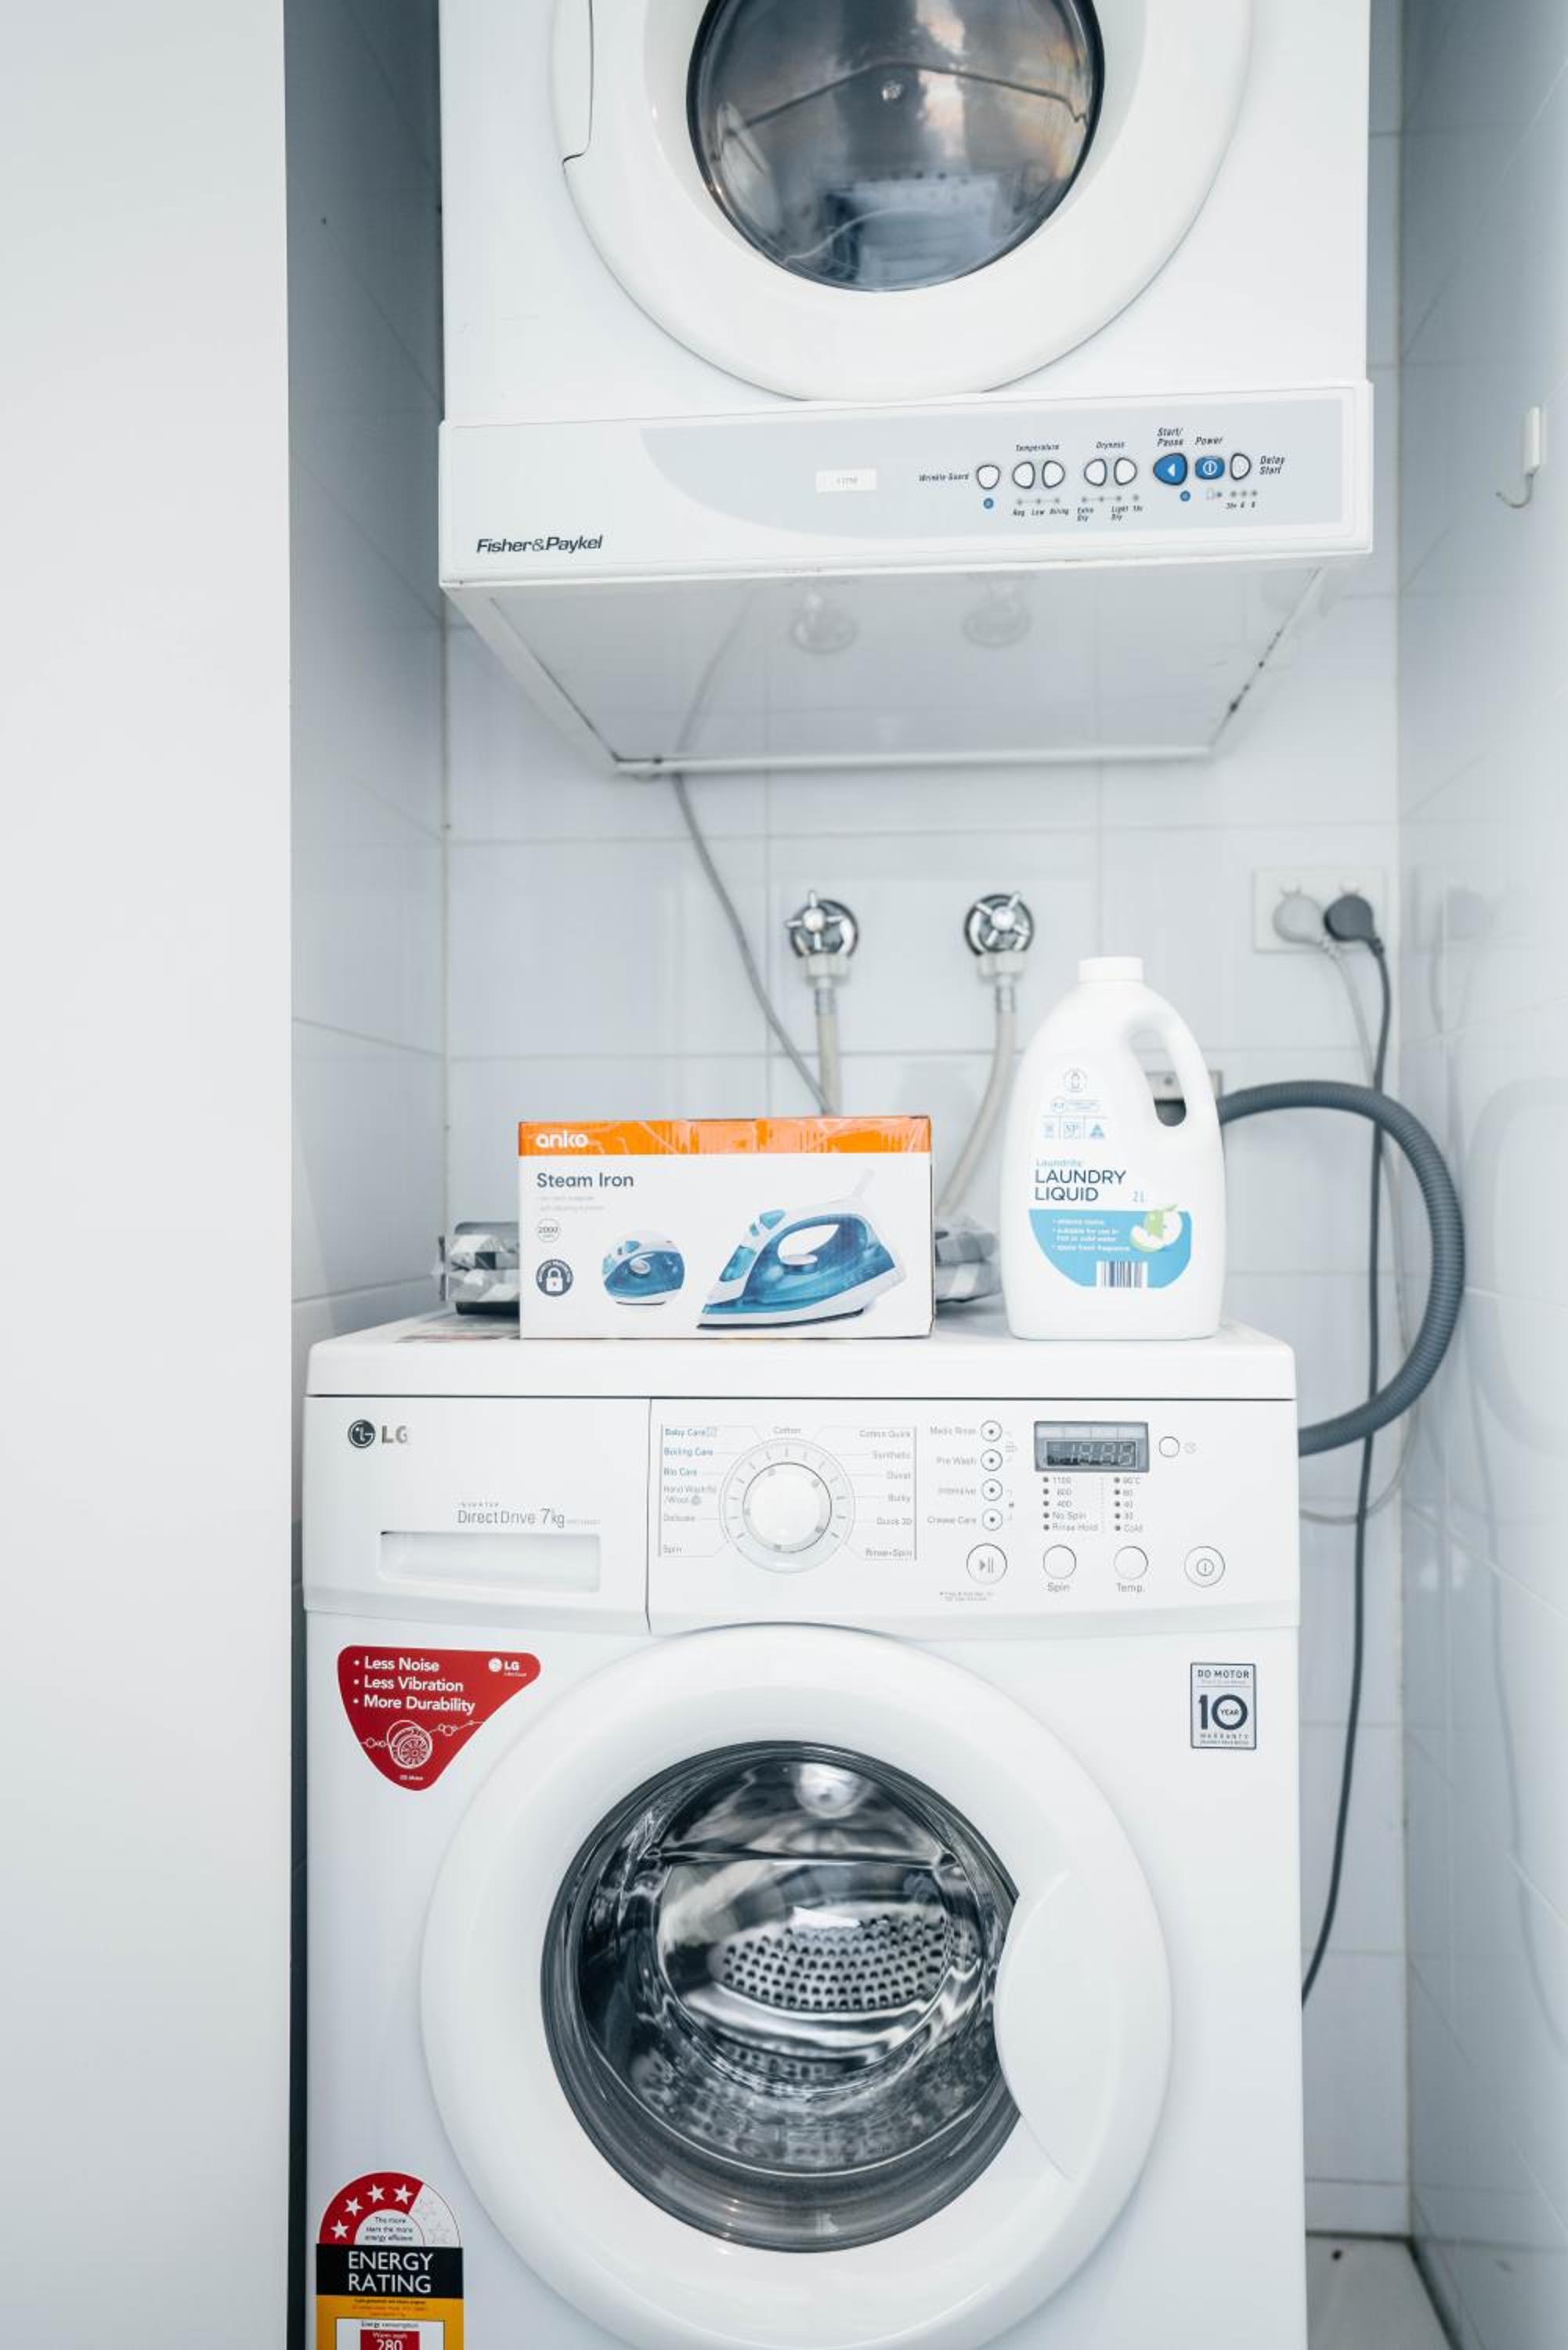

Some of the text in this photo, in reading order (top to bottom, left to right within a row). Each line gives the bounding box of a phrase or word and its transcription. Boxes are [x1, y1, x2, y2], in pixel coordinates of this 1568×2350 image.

[1096, 441, 1125, 450] Dryness
[1157, 438, 1183, 447] Pause
[1195, 436, 1223, 446] Power
[1016, 443, 1060, 453] Temperature
[1259, 455, 1285, 466] Delay
[1259, 466, 1282, 475] Start
[476, 534, 603, 554] Fisher&Paykel
[536, 1130, 590, 1149] anko
[537, 1172, 634, 1188] Steam Iron
[1035, 1170, 1126, 1184] LAUNDRY
[1035, 1187, 1099, 1202] LIQUID
[381, 1425, 408, 1444] LG
[665, 1428, 685, 1438] Baby
[695, 1448, 714, 1456] Care
[937, 1456, 977, 1465] Pre Wash
[679, 1467, 698, 1477] Care
[1068, 1511, 1087, 1521] Spin
[1124, 1524, 1143, 1532] Cold
[663, 1544, 683, 1554] Spin
[1046, 1582, 1070, 1593] Spin
[1117, 1582, 1146, 1593] Temp.
[365, 1656, 439, 1672] Less Noise
[504, 1661, 520, 1671] LG
[1214, 1669, 1250, 1679] MOTOR
[364, 1675, 464, 1693] Less Vibration
[364, 1694, 475, 1716] More Durability
[1198, 1694, 1248, 1730] 10
[349, 2251, 433, 2272] ENERGY
[349, 2272, 432, 2294] RATING
[377, 2338, 404, 2350] 280
